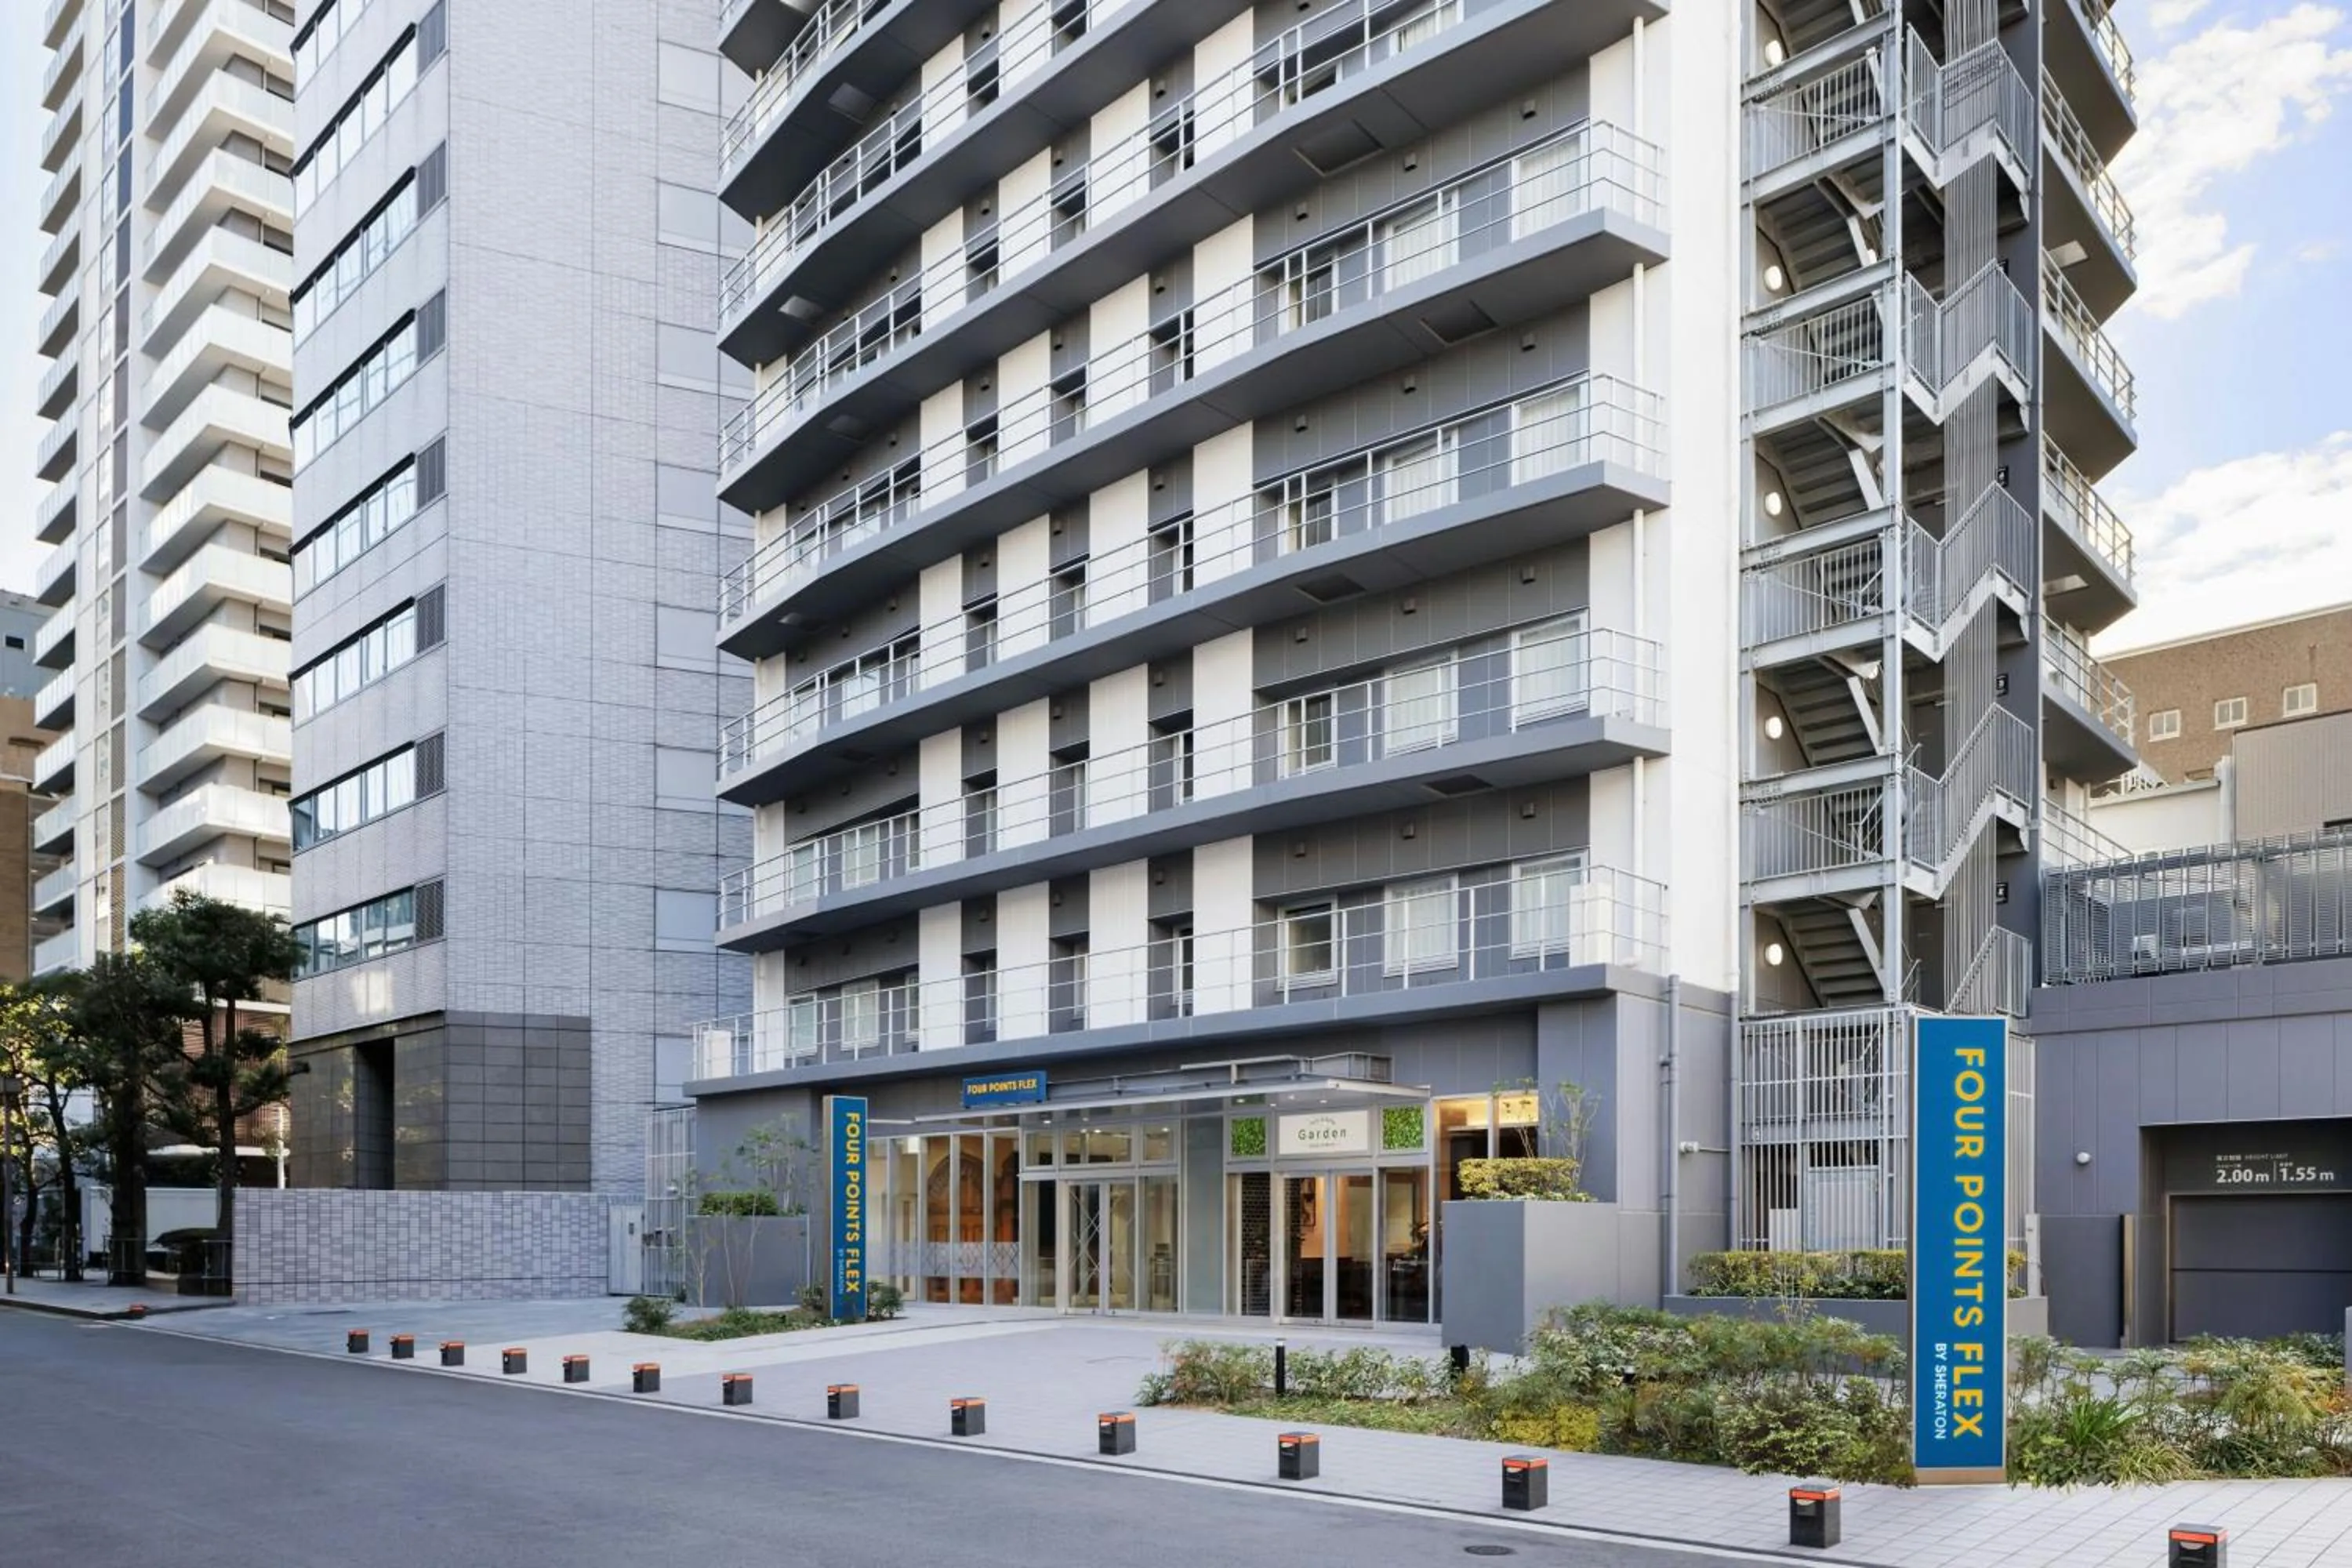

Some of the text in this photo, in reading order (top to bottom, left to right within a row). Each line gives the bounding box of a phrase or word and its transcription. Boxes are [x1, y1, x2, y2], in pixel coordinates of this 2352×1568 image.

[967, 1078, 1037, 1094] FOUR POINTS FLEX
[1298, 1128, 1347, 1141] Garden
[845, 1112, 860, 1293] FOUR POINTS FLEX
[1953, 1048, 1984, 1437] FOUR POINTS FLEX
[1934, 1343, 1947, 1439] BY SHERATON
